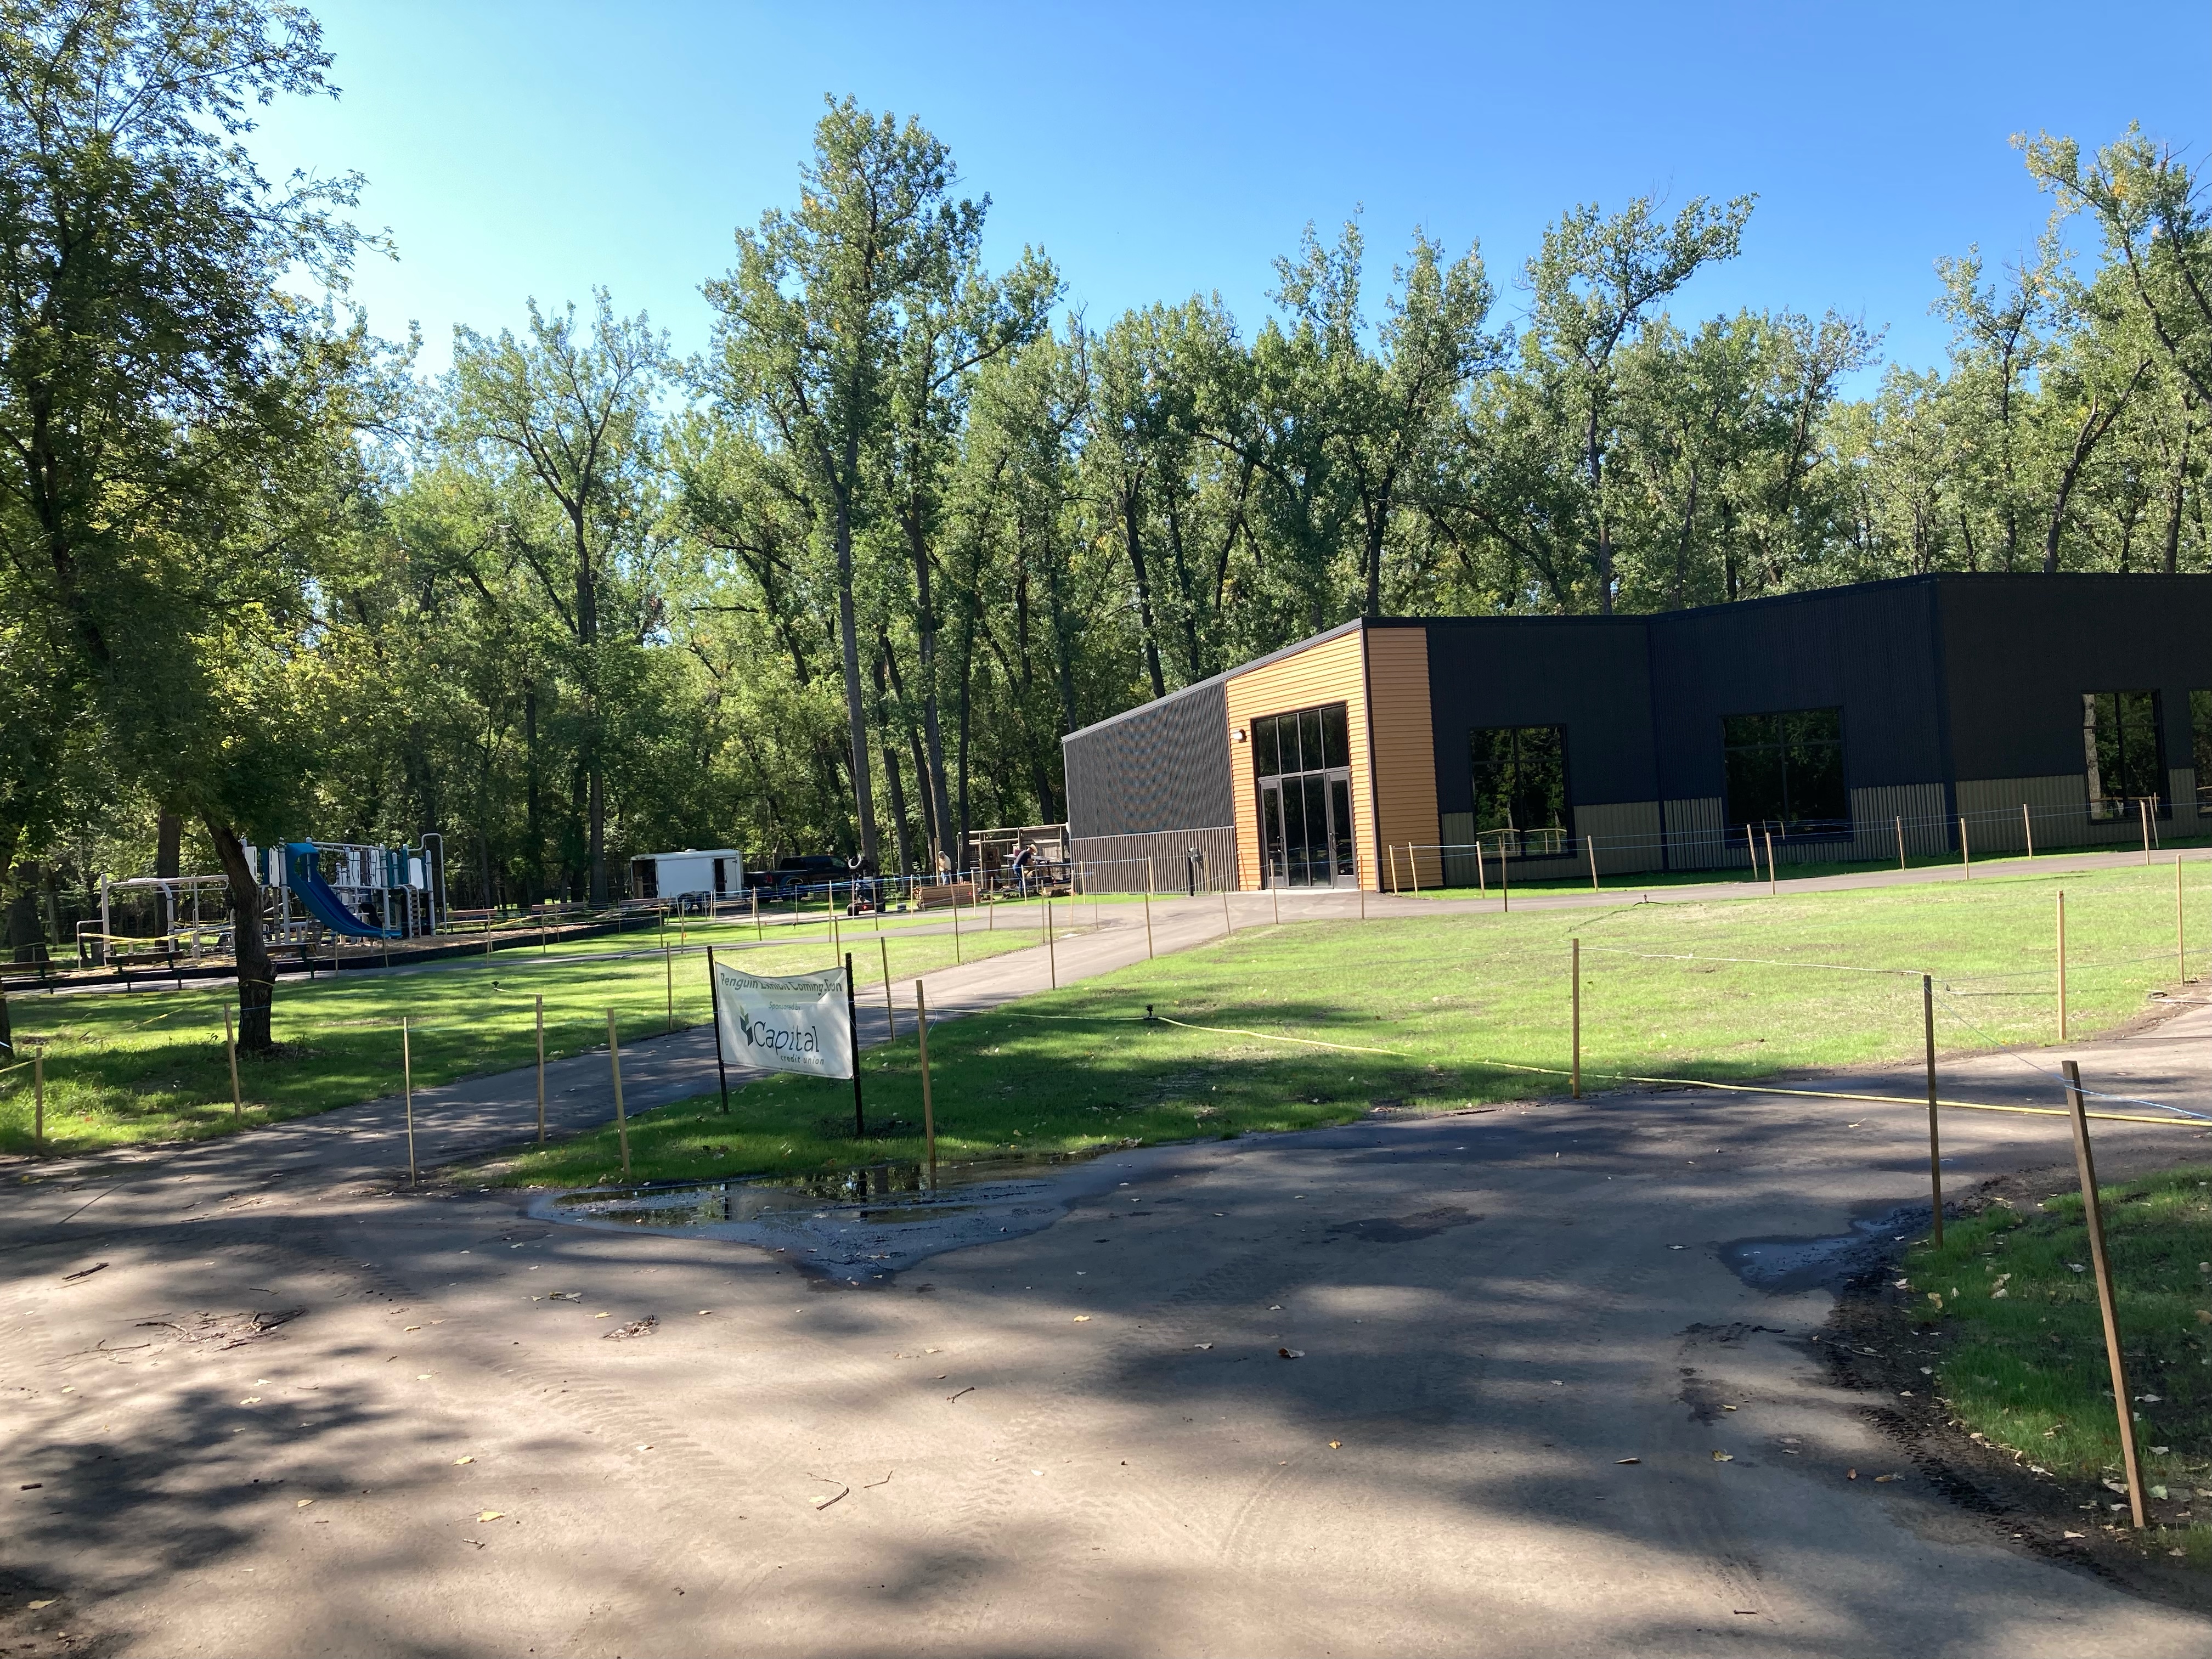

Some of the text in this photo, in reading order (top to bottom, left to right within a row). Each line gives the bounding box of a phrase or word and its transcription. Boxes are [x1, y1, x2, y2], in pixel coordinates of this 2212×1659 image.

[720, 973, 758, 990] Penguin
[788, 981, 823, 996] Coming
[824, 979, 842, 992] Soon
[769, 1001, 802, 1013] Sponsored by
[754, 1020, 819, 1055] Capital
[780, 1053, 824, 1065] credit union
